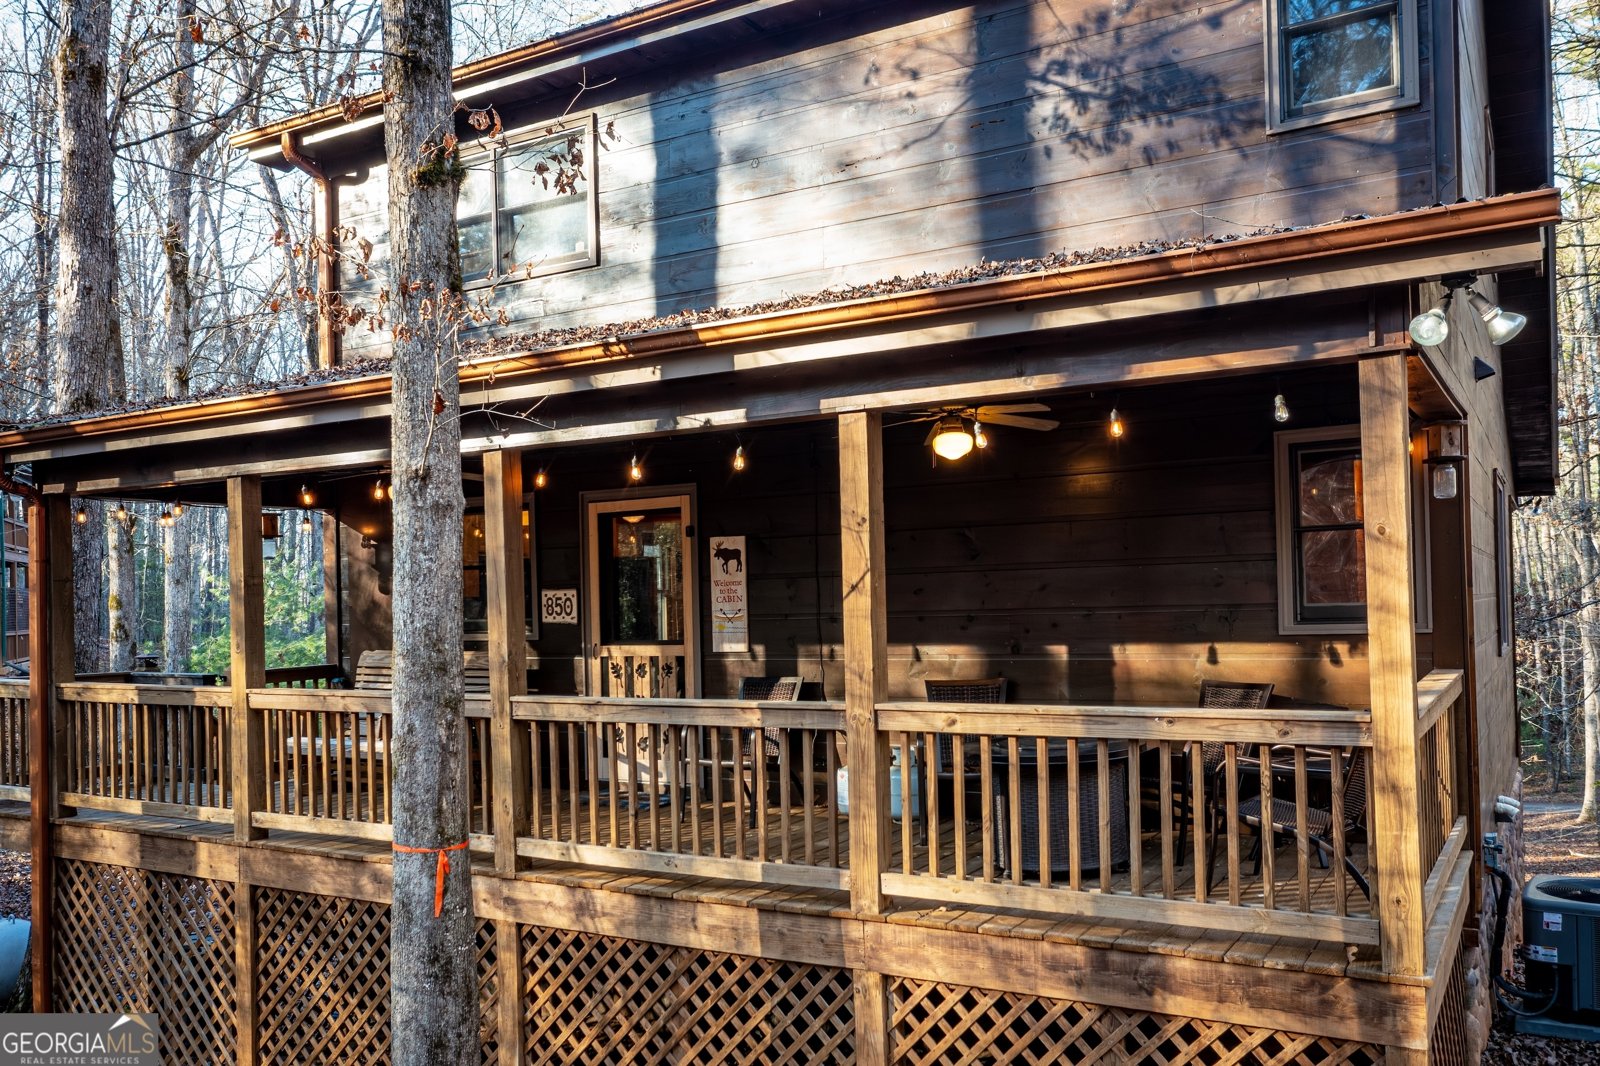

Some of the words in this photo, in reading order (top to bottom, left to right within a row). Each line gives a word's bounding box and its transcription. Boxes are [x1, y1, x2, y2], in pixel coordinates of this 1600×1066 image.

[713, 579, 742, 587] Welcome
[716, 595, 743, 603] CABIN
[546, 597, 573, 616] 850
